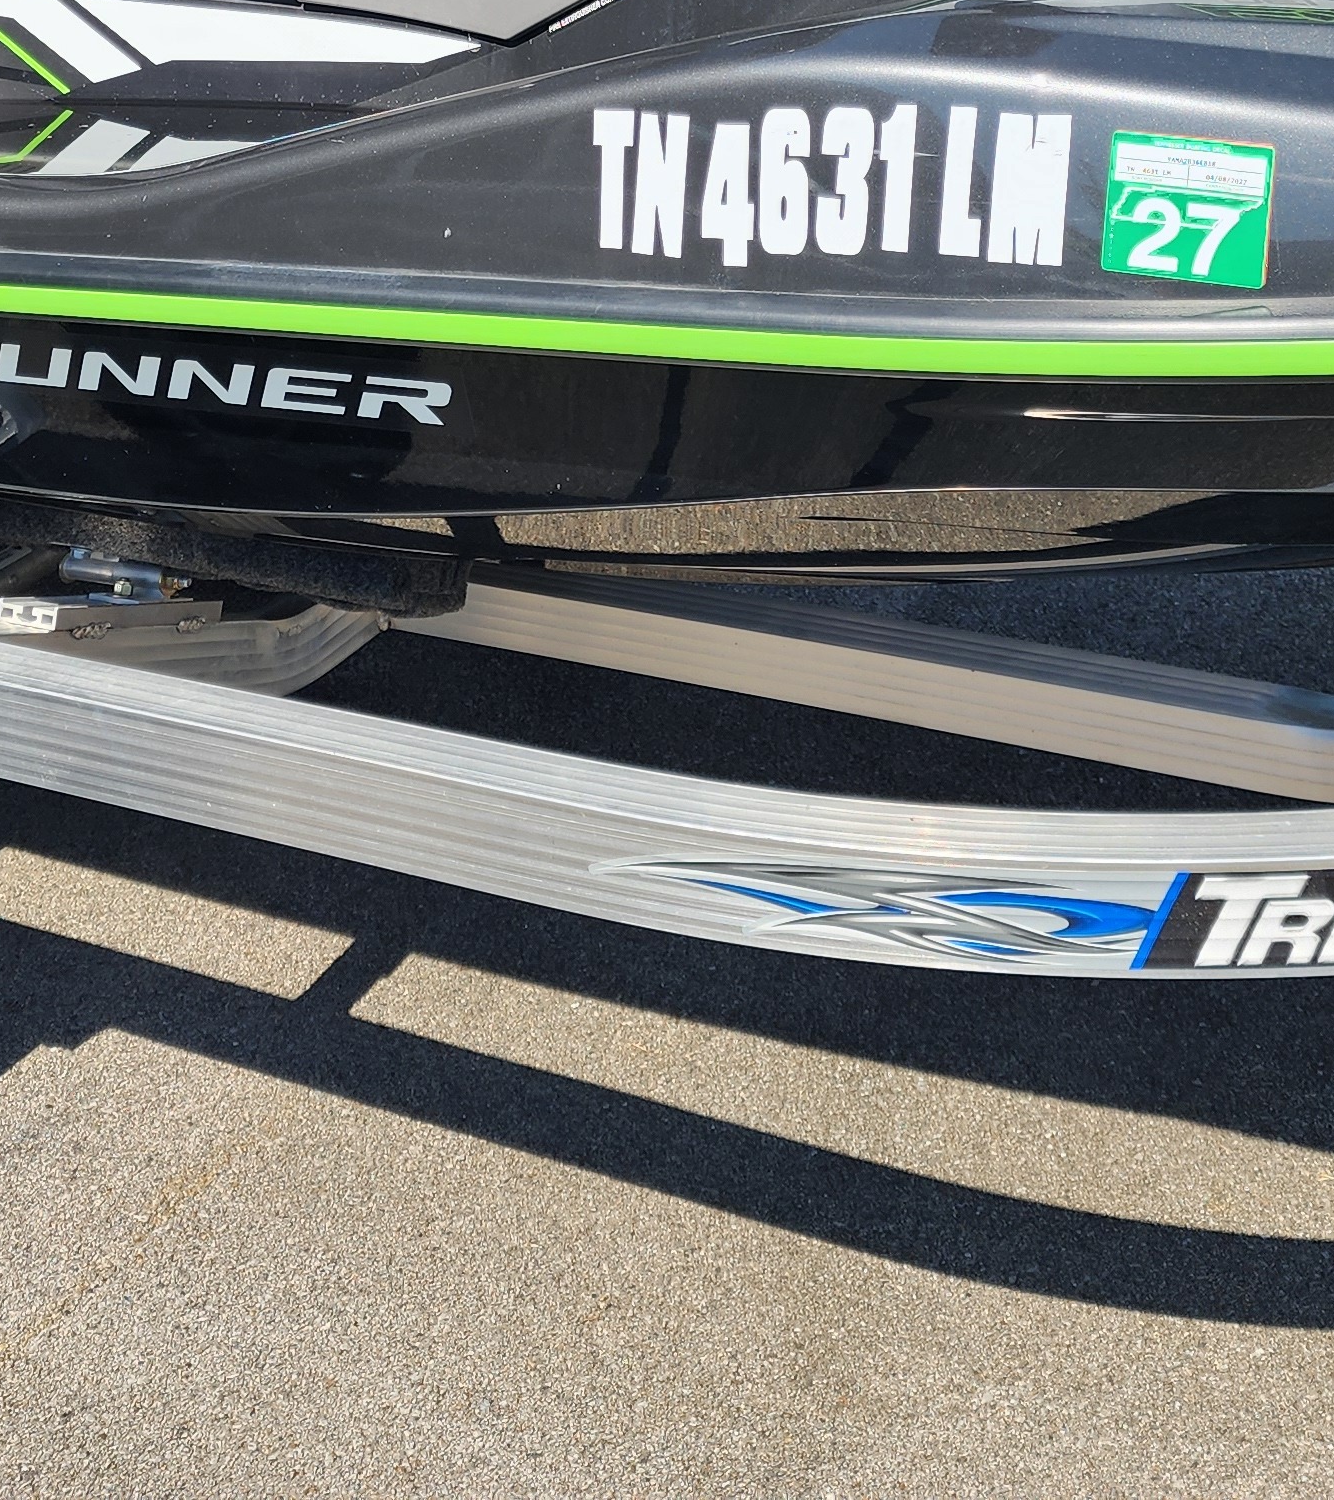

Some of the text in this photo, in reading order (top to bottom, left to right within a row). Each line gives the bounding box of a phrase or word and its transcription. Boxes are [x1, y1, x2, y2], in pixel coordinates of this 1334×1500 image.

[593, 103, 1073, 269] TN 4631 LM
[1127, 197, 1242, 277] 27
